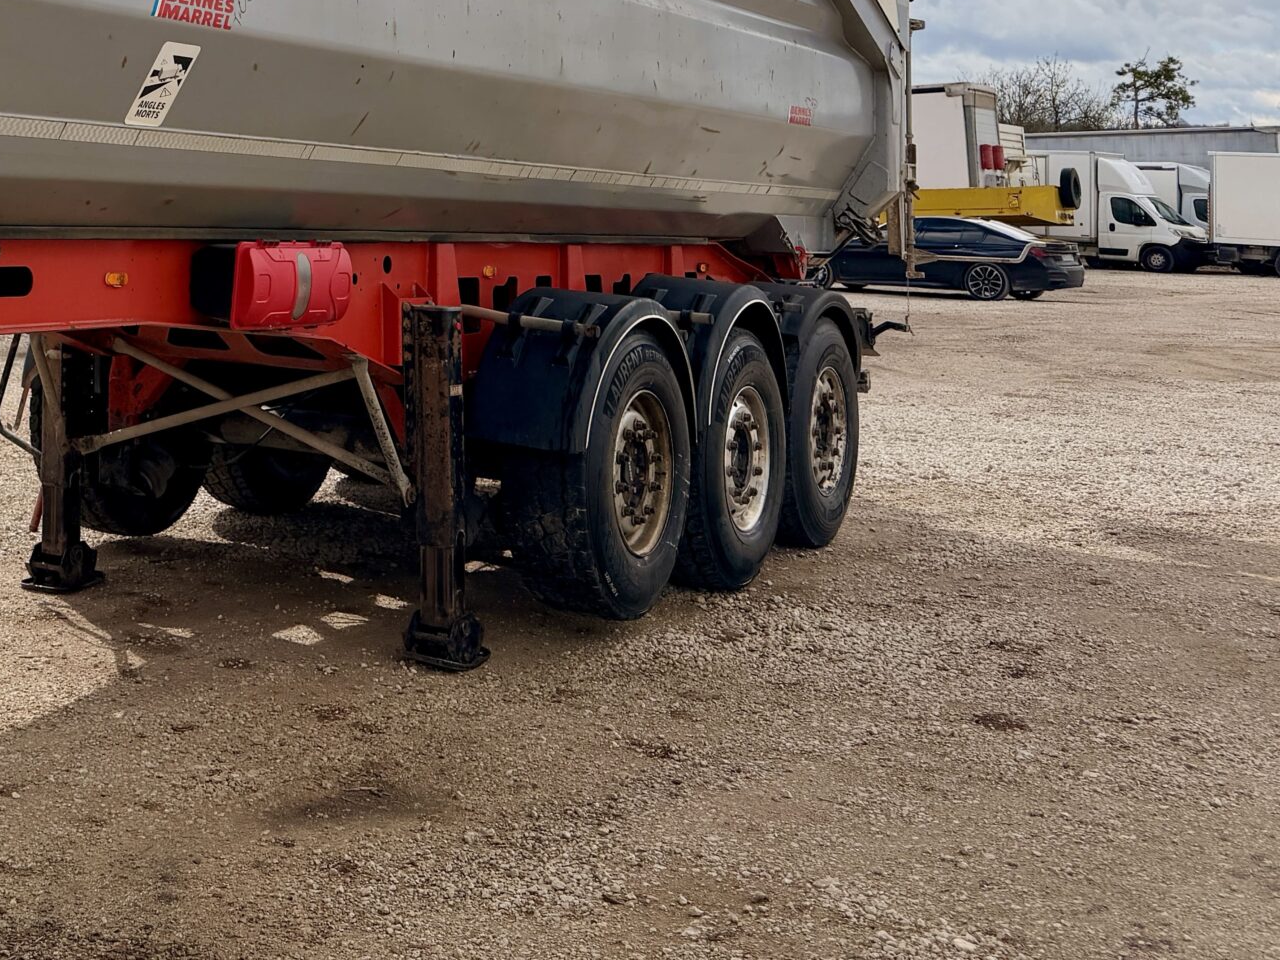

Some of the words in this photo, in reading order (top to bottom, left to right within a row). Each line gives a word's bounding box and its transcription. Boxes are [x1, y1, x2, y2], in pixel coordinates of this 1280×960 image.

[162, 3, 232, 30] MARREL
[135, 109, 160, 119] MORTS
[138, 100, 166, 111] ANGLES
[606, 346, 643, 417] LAURENT
